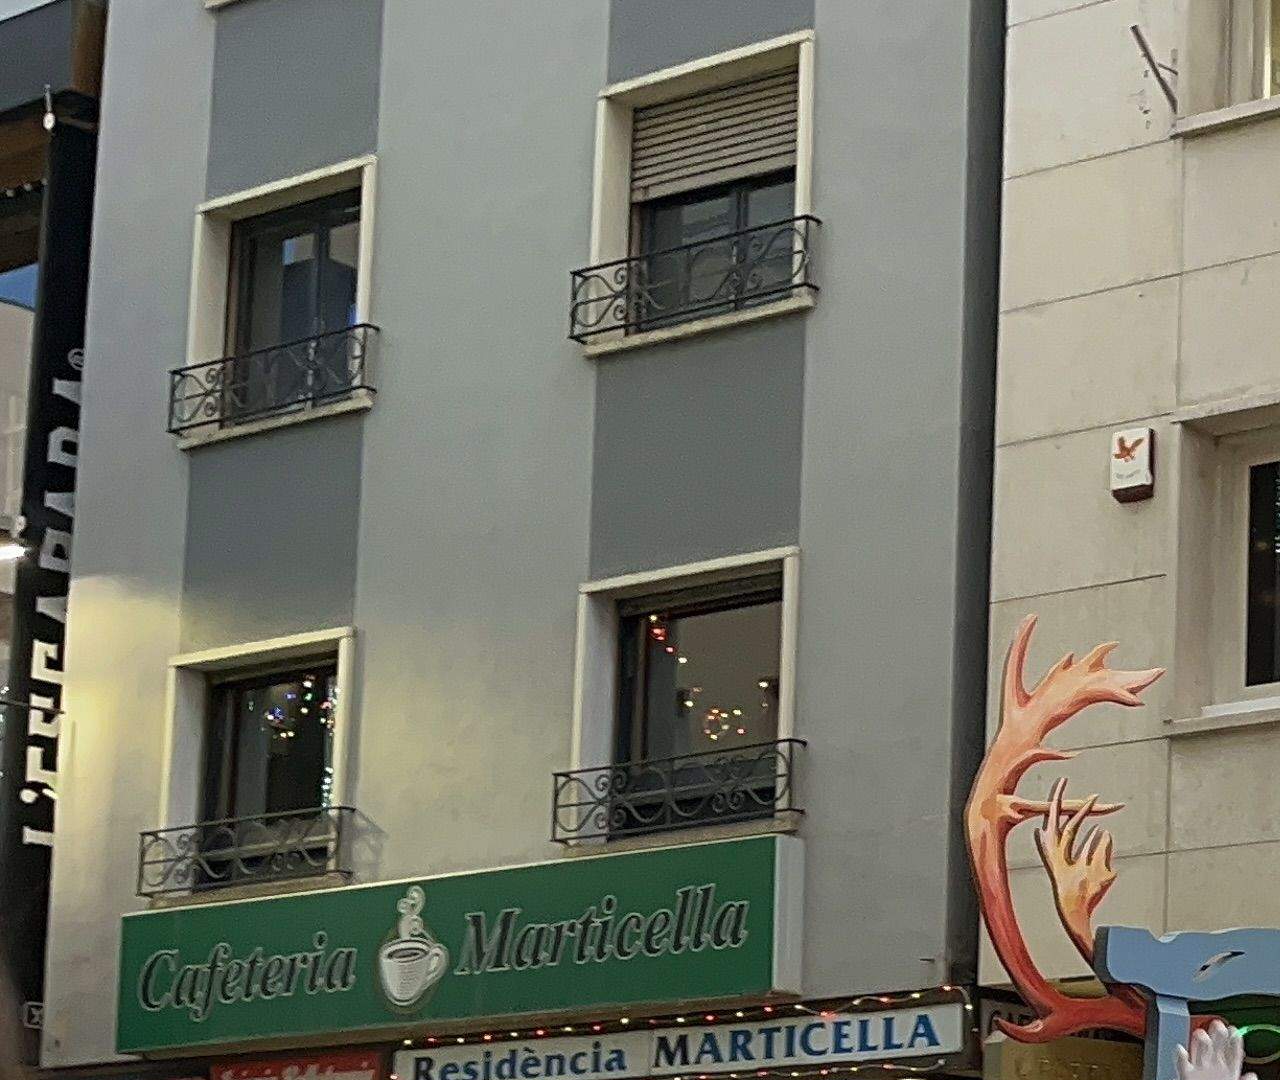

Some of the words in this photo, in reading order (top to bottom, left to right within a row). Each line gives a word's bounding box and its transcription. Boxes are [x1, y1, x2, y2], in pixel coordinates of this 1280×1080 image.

[138, 931, 357, 1021] Cafeteria
[454, 884, 749, 975] Marticella
[653, 1014, 941, 1068] MARTICELLA
